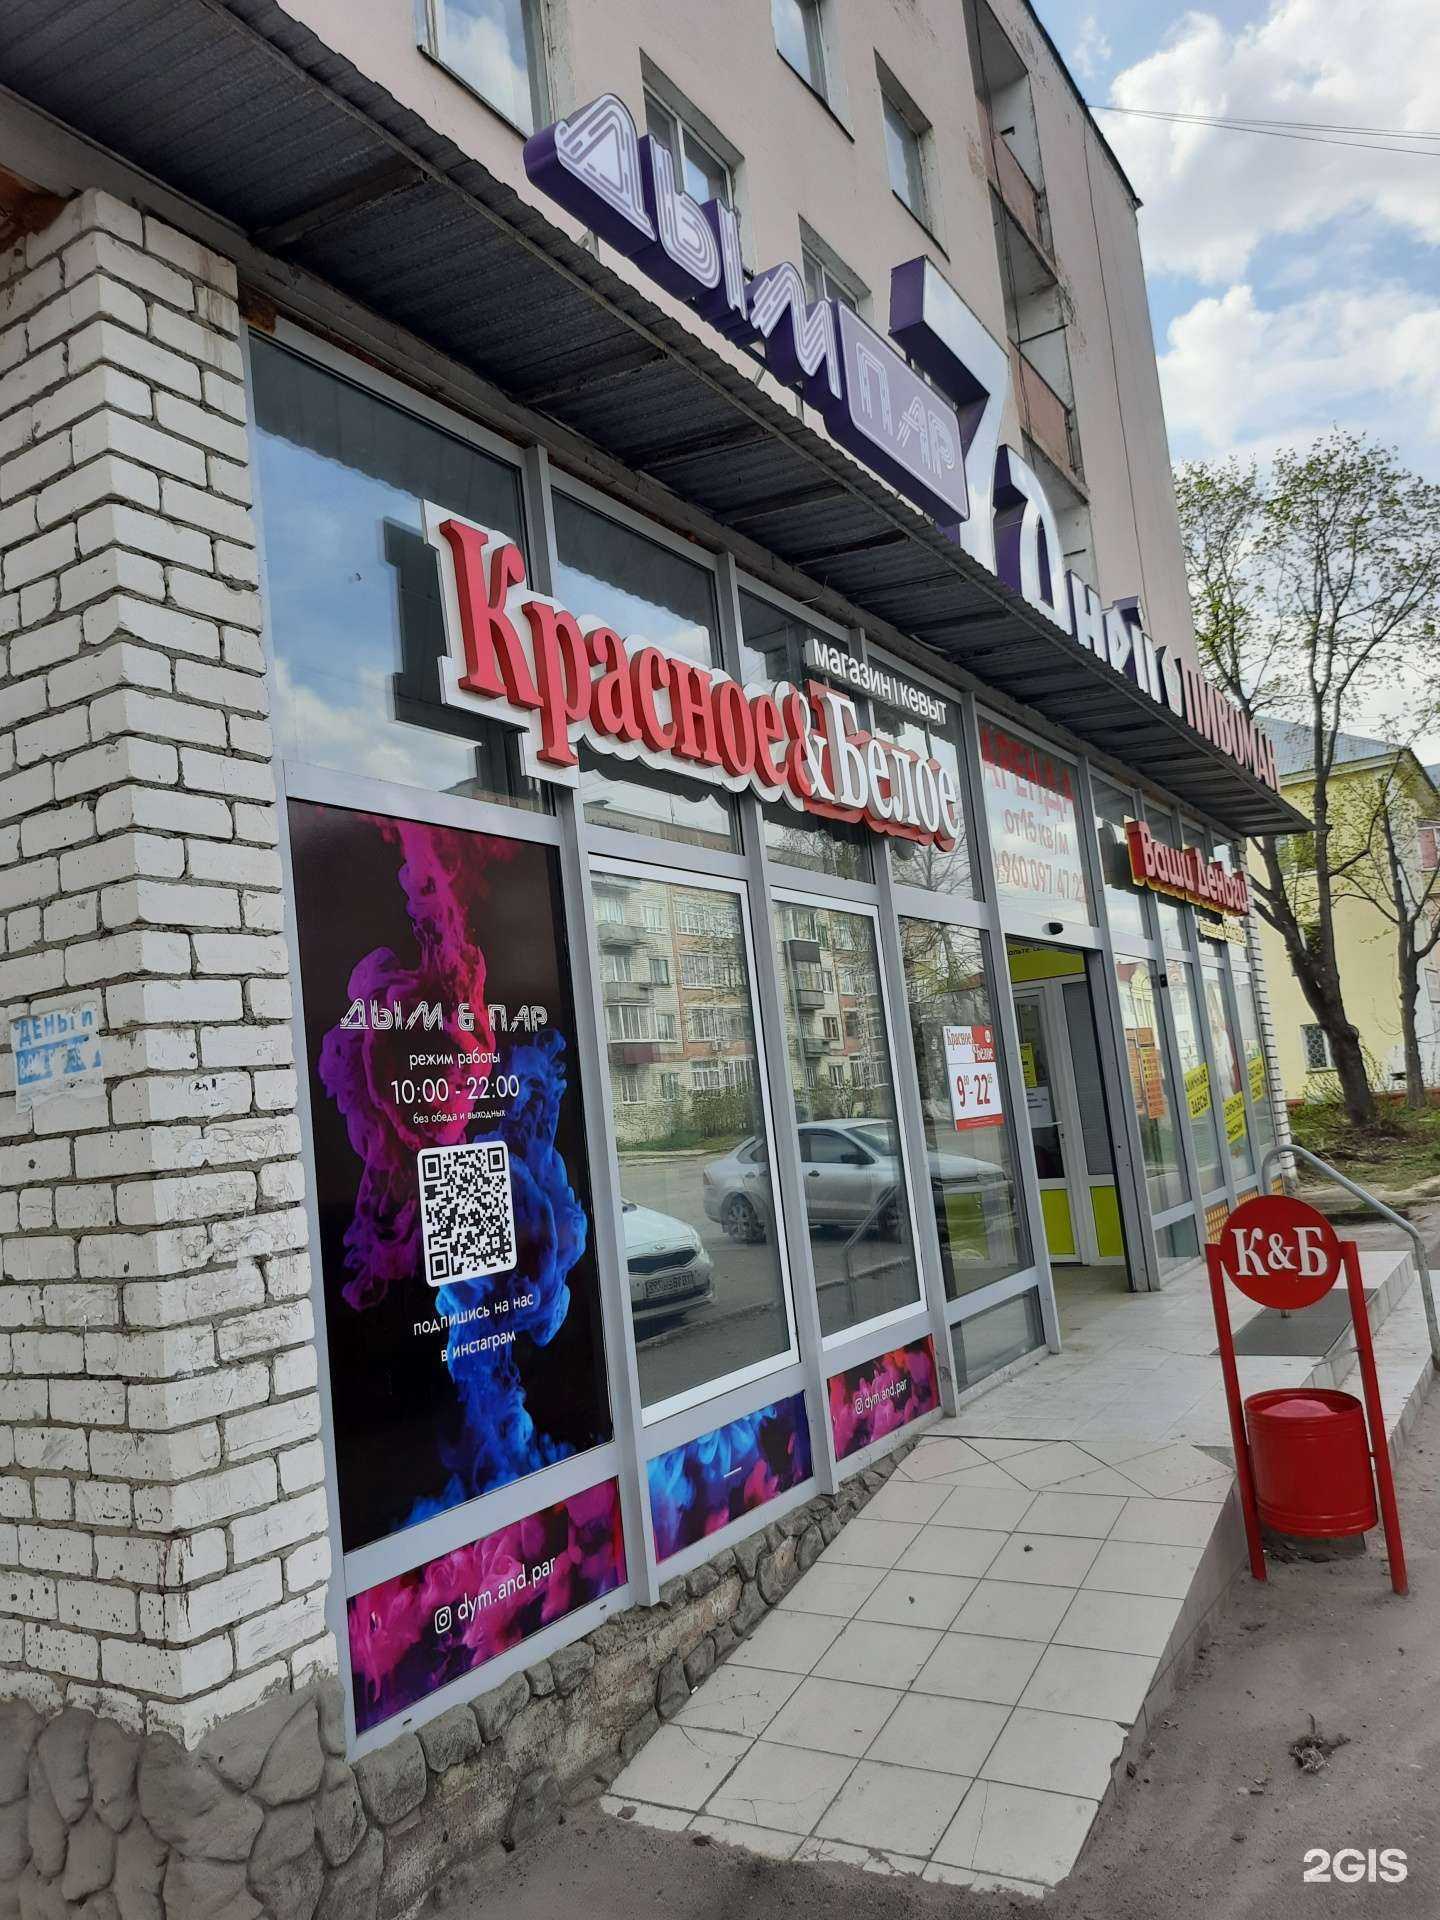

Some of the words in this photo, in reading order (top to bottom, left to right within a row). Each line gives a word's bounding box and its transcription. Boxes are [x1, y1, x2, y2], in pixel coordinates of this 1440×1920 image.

[855, 341, 956, 479] ПАР
[813, 638, 892, 700] магазин
[899, 681, 947, 725] кевыт
[1180, 660, 1281, 794] ПИВОМАН
[340, 998, 444, 1031] ДЫМ
[487, 1004, 549, 1032] ПАР
[409, 1053, 454, 1071] режим
[457, 1047, 501, 1068] работы
[390, 1078, 449, 1105] 10:00
[466, 1075, 520, 1100] 22:00
[413, 1112, 429, 1124] без
[431, 1110, 458, 1123] обеда
[467, 1109, 506, 1120] выходных
[413, 1305, 490, 1335] подпишись
[494, 1300, 509, 1314] на
[513, 1294, 534, 1309] нас
[441, 1349, 448, 1361] в
[452, 1330, 516, 1359] инстаграм
[864, 1378, 908, 1410] dym.and.par
[457, 1557, 556, 1621] dym.and.par
